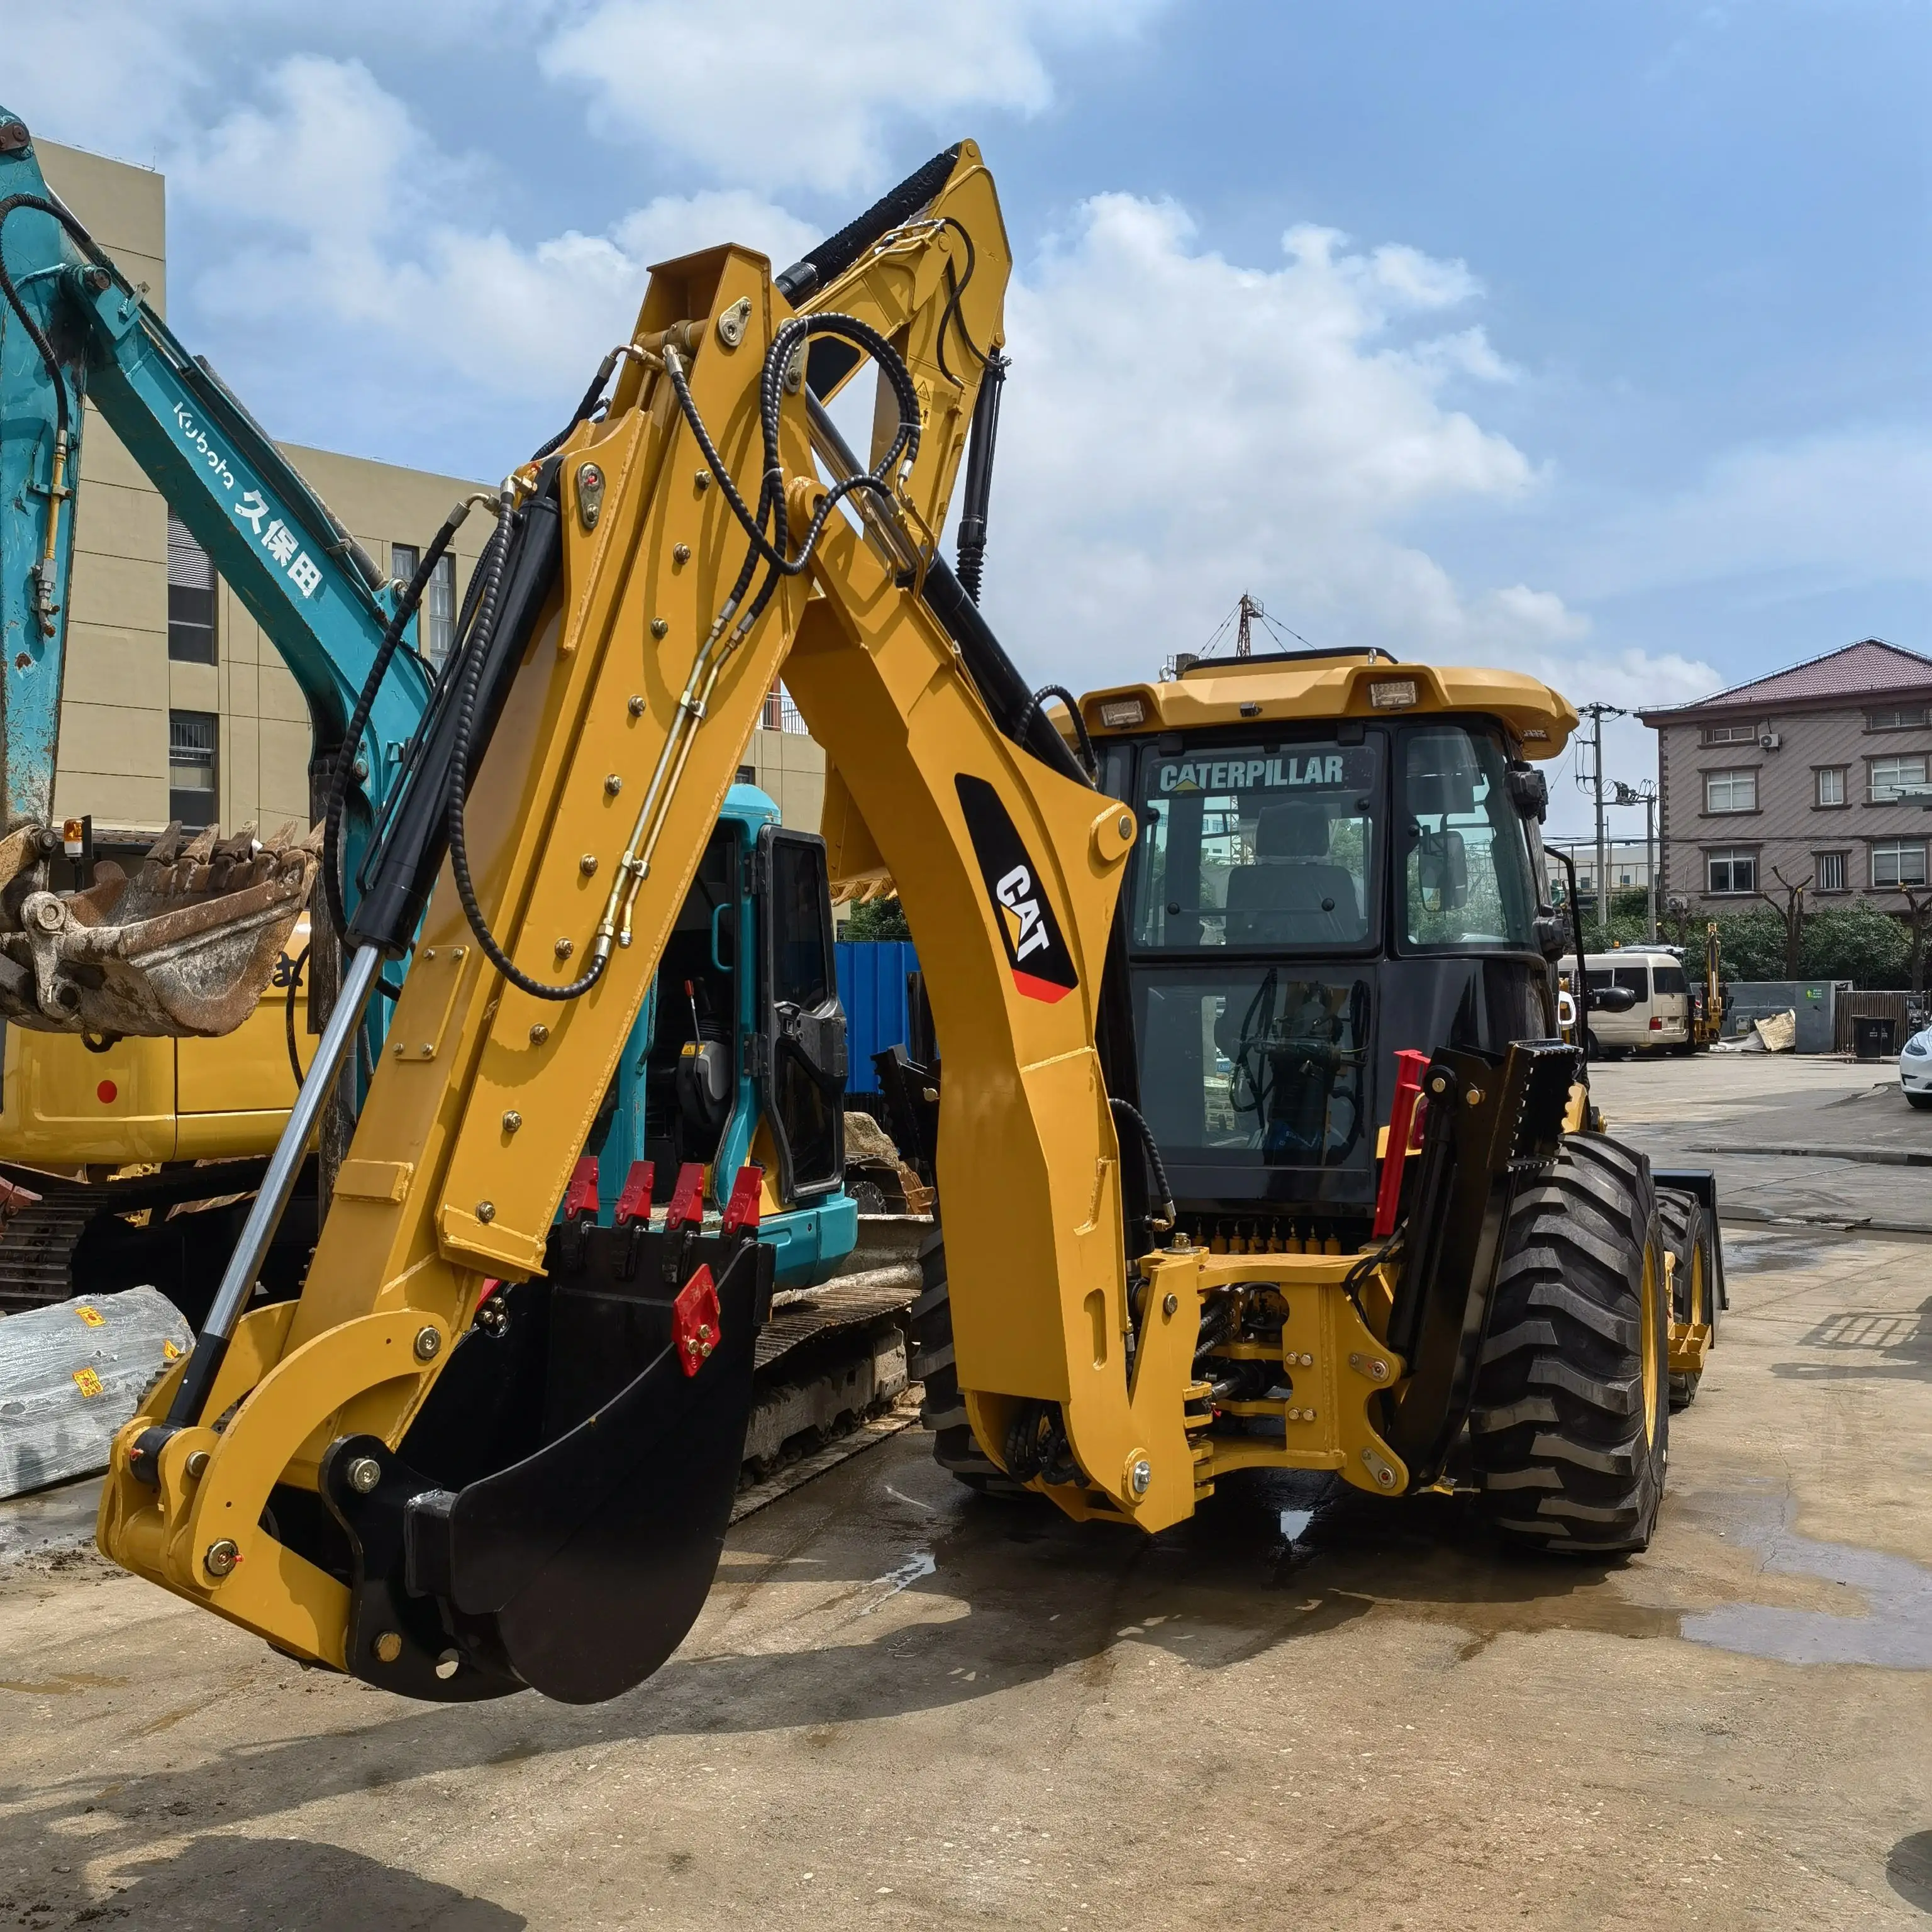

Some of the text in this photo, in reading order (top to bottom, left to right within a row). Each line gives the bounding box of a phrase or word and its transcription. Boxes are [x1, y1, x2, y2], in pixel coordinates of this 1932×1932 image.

[174, 401, 234, 490] Kubota
[235, 489, 323, 599] 久保田
[1160, 755, 1343, 792] CATERPILLAR
[996, 865, 1050, 962] CAT
